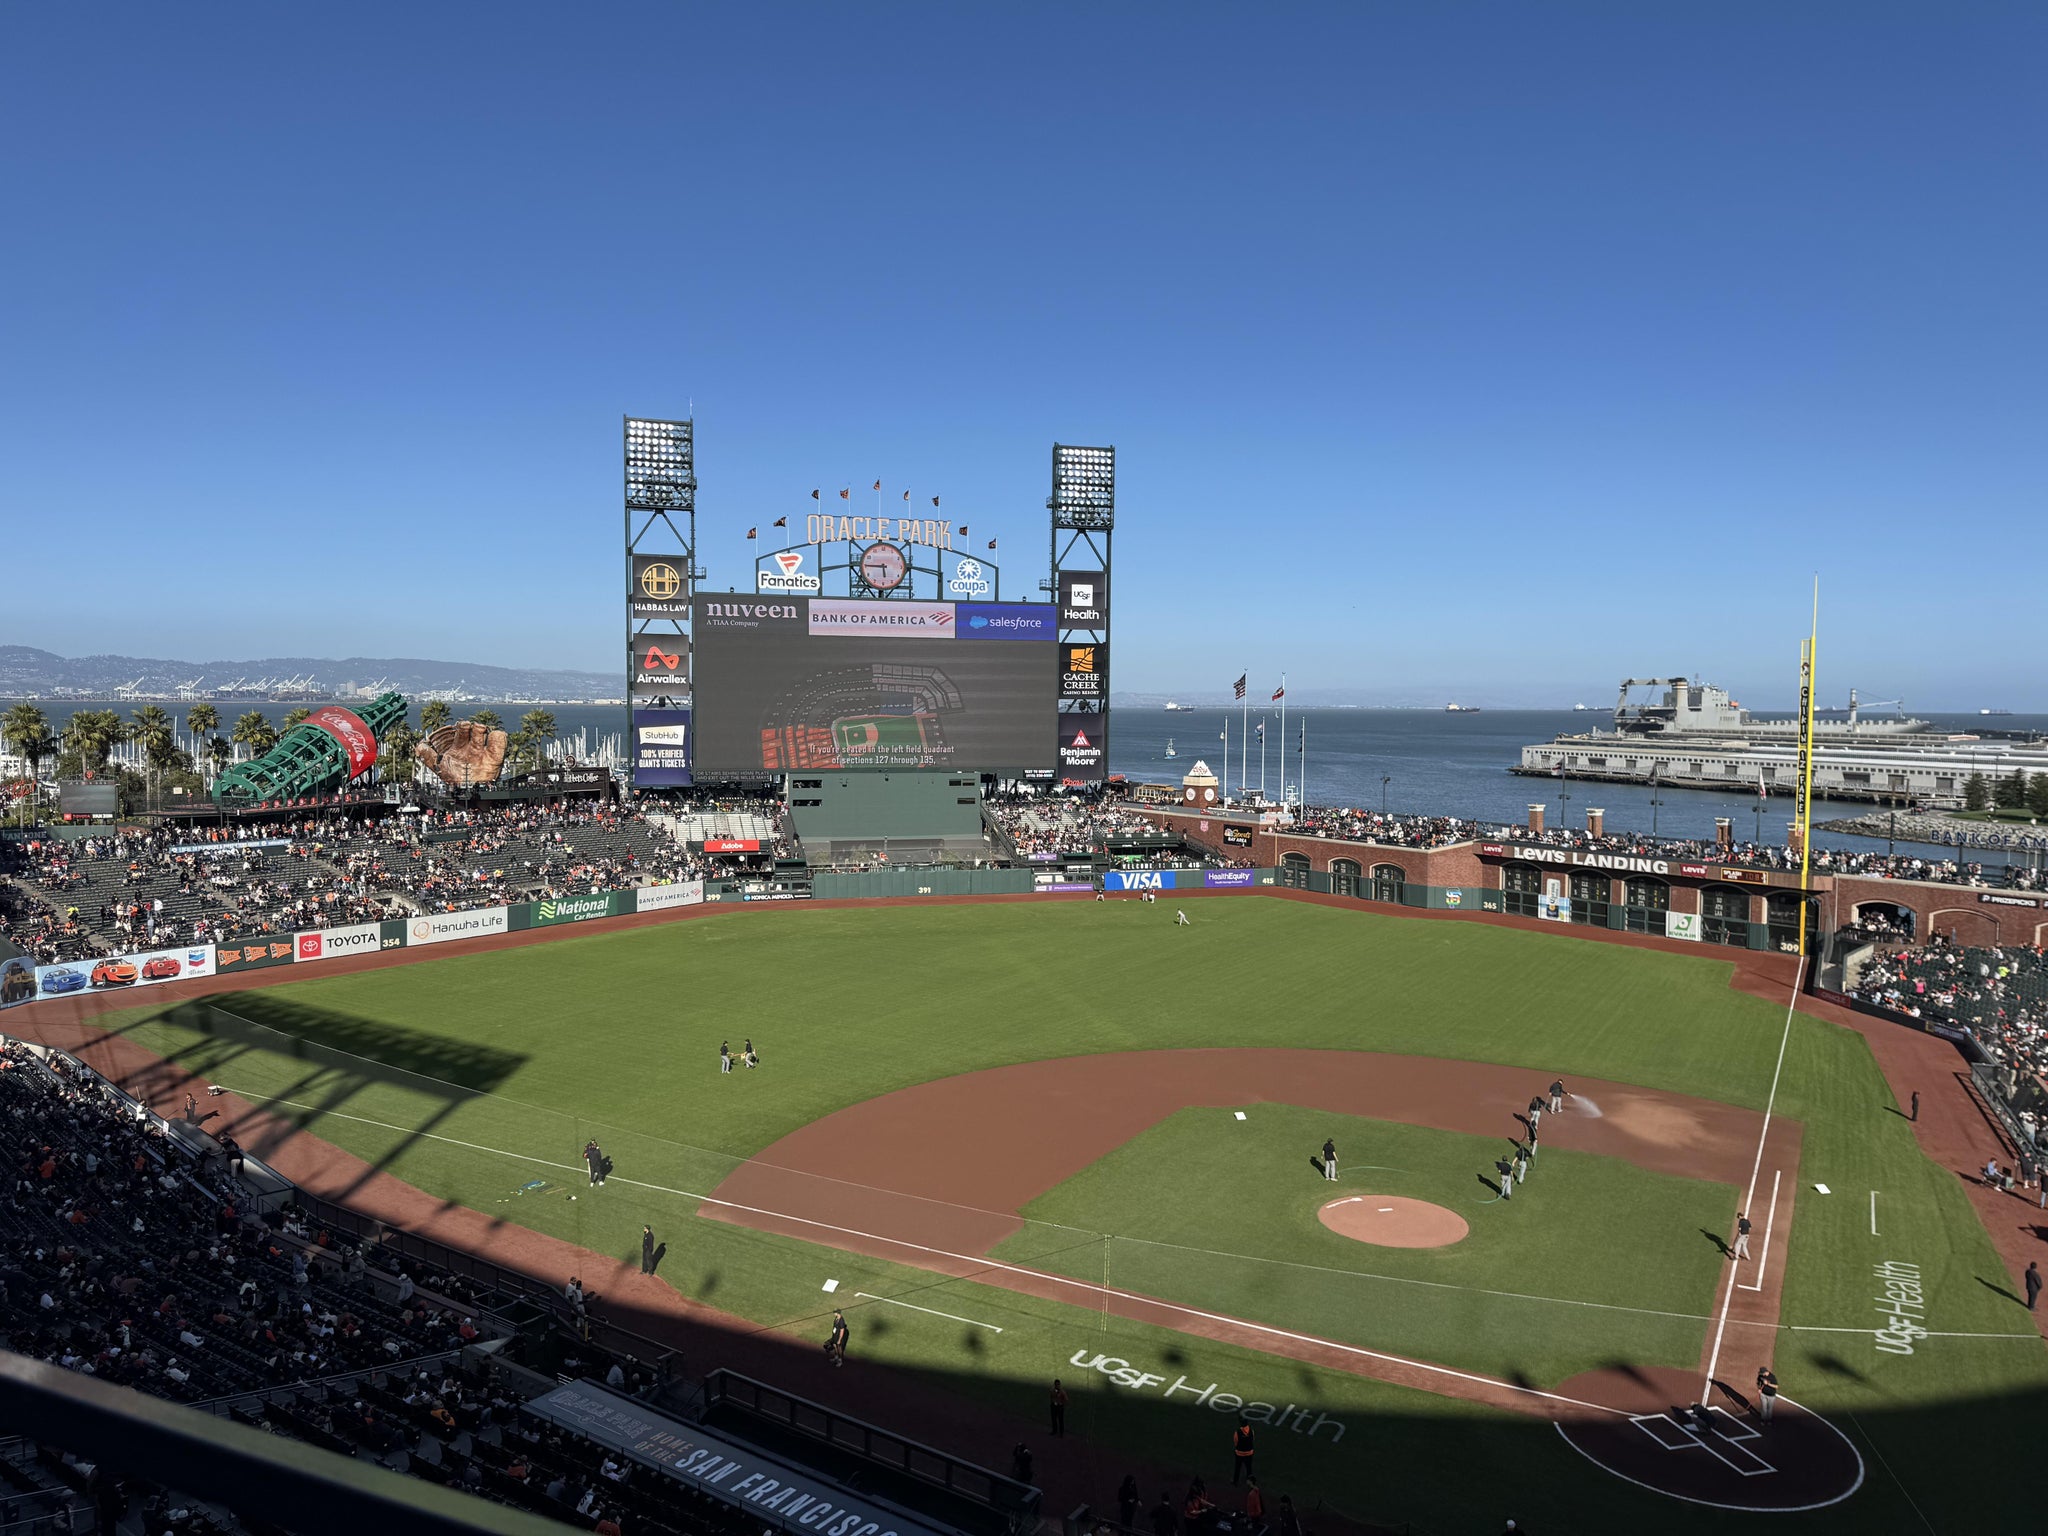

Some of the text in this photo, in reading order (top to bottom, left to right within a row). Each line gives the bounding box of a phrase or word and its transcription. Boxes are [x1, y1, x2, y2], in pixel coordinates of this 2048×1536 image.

[807, 514, 953, 551] ORACLE PARK
[760, 573, 818, 588] Fanatics
[952, 581, 986, 592] coupa
[634, 602, 687, 612] HABBAS LAW
[706, 602, 798, 619] nuveen
[812, 613, 926, 625] BANK OF AMERICA
[1064, 609, 1100, 620] Health
[729, 620, 759, 628] Company
[989, 616, 1042, 629] salesforce
[637, 674, 687, 684] Airwallex
[1063, 673, 1100, 681] CACHE
[1064, 681, 1098, 690] CREEK
[645, 731, 679, 739] StubHub
[640, 749, 684, 759] 100% VERIFIED
[817, 745, 840, 755] you're
[841, 745, 867, 753] seated
[868, 745, 876, 753] in
[878, 745, 890, 753] the
[891, 745, 904, 753] left
[905, 745, 922, 753] field
[923, 745, 955, 755] quadrant
[1060, 747, 1101, 757] Benjamin
[638, 759, 686, 768] GIANTS TICKETS
[831, 756, 936, 766] of sections 127 through 135,
[1066, 756, 1095, 765] Moore
[582, 772, 599, 783] Coffee
[1931, 829, 1980, 844] BANK
[1988, 833, 2012, 846] OF
[1572, 852, 1669, 875] LANDING
[1118, 873, 1163, 889] VISA
[1208, 872, 1250, 881] HealthEquity
[918, 886, 931, 894] 391
[639, 897, 655, 905] BANK
[663, 892, 690, 901] AMERICA
[556, 896, 610, 916] National
[1483, 901, 1497, 909] 365
[574, 910, 607, 921] Car Rental
[432, 916, 503, 934] Hanwha Life
[326, 933, 377, 949] TOYOTA
[382, 938, 401, 948] 354
[1780, 942, 1799, 953] 309
[1873, 1261, 1925, 1320] Health
[1069, 1349, 1167, 1389] UCSF
[1163, 1375, 1347, 1444] Health
[549, 1391, 653, 1440] ORACLE PARK
[650, 1431, 694, 1453] HOME
[634, 1441, 677, 1462] OF THE
[674, 1449, 898, 1536] SAN FRANCISC
